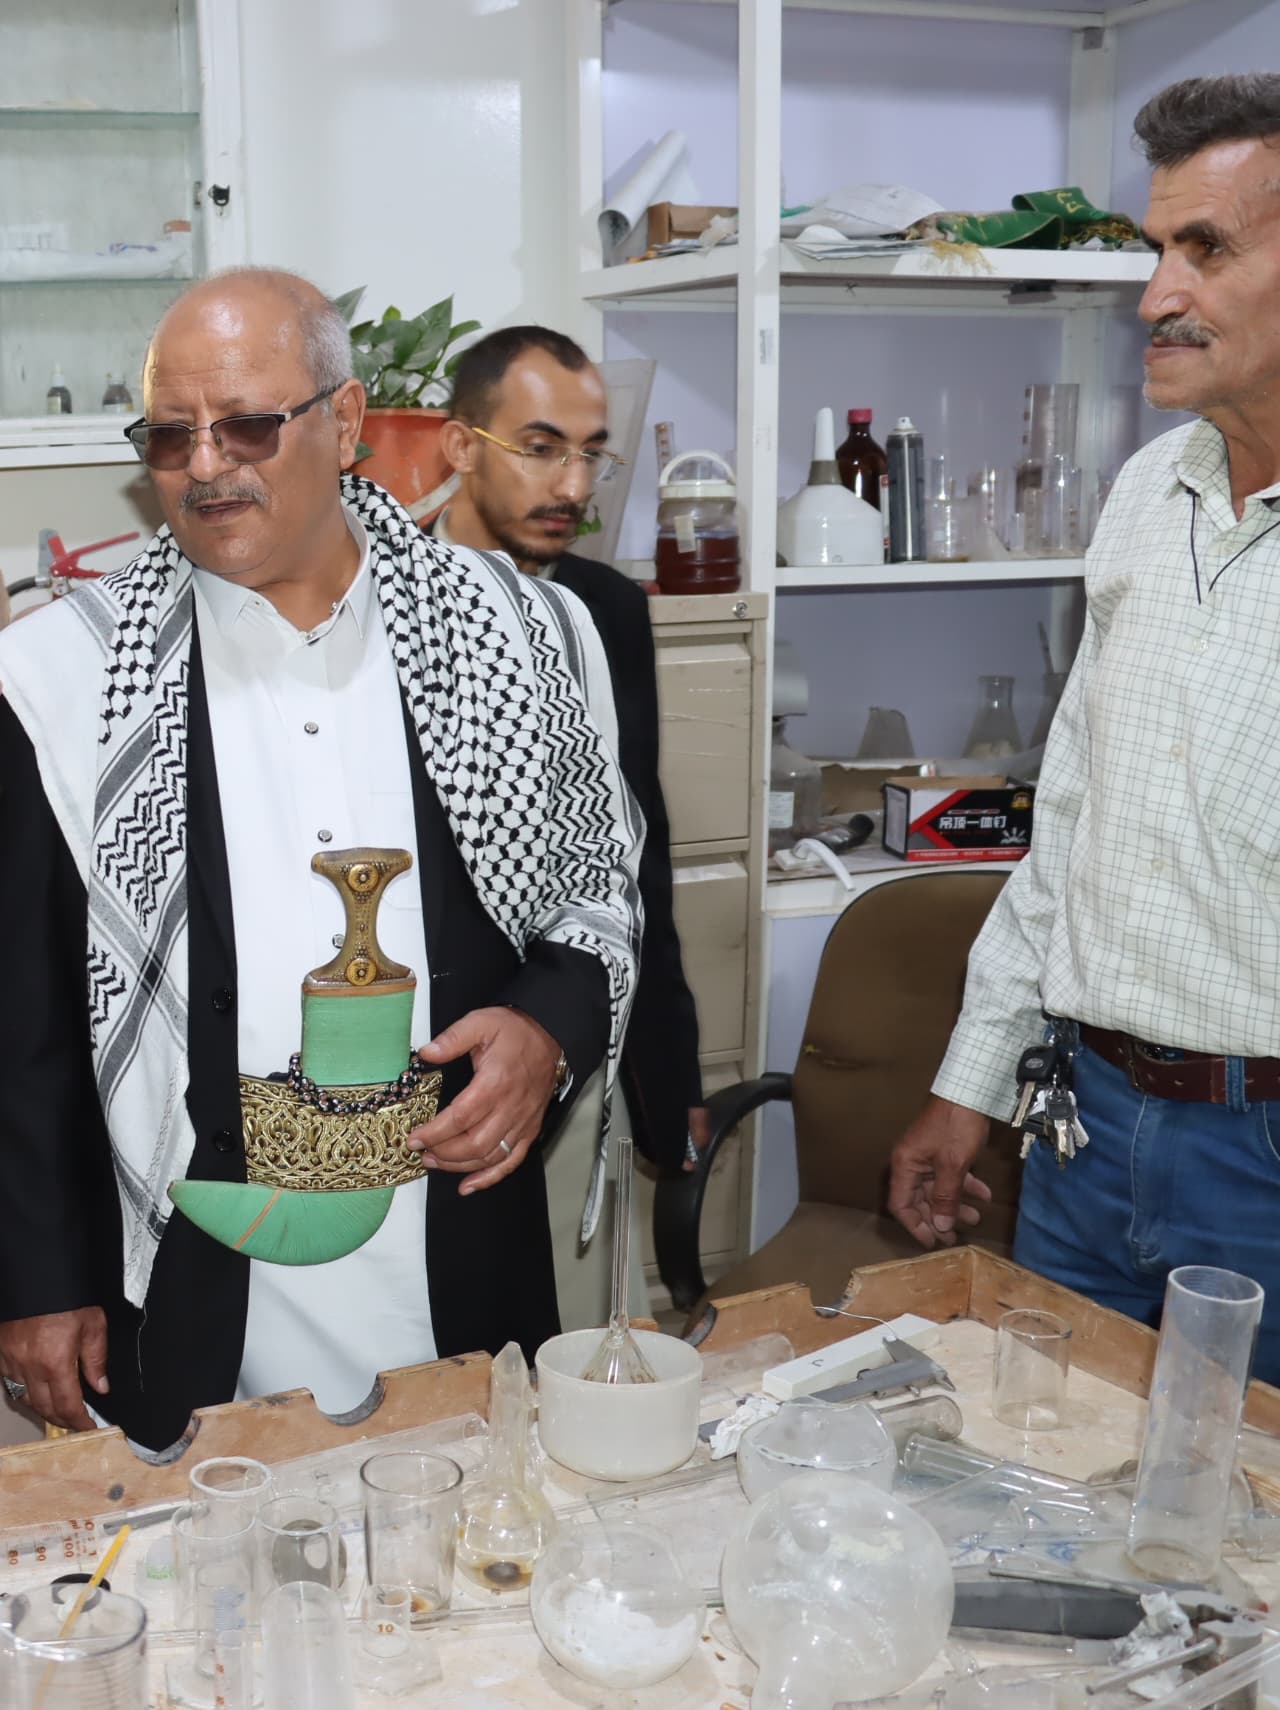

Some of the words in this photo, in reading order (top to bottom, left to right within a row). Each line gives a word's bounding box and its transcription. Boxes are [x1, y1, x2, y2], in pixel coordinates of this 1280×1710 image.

[939, 815, 1007, 829] 吊顶一体钉
[36, 1546, 47, 1561] 90
[64, 1536, 74, 1558] 100
[378, 1624, 395, 1633] 10
